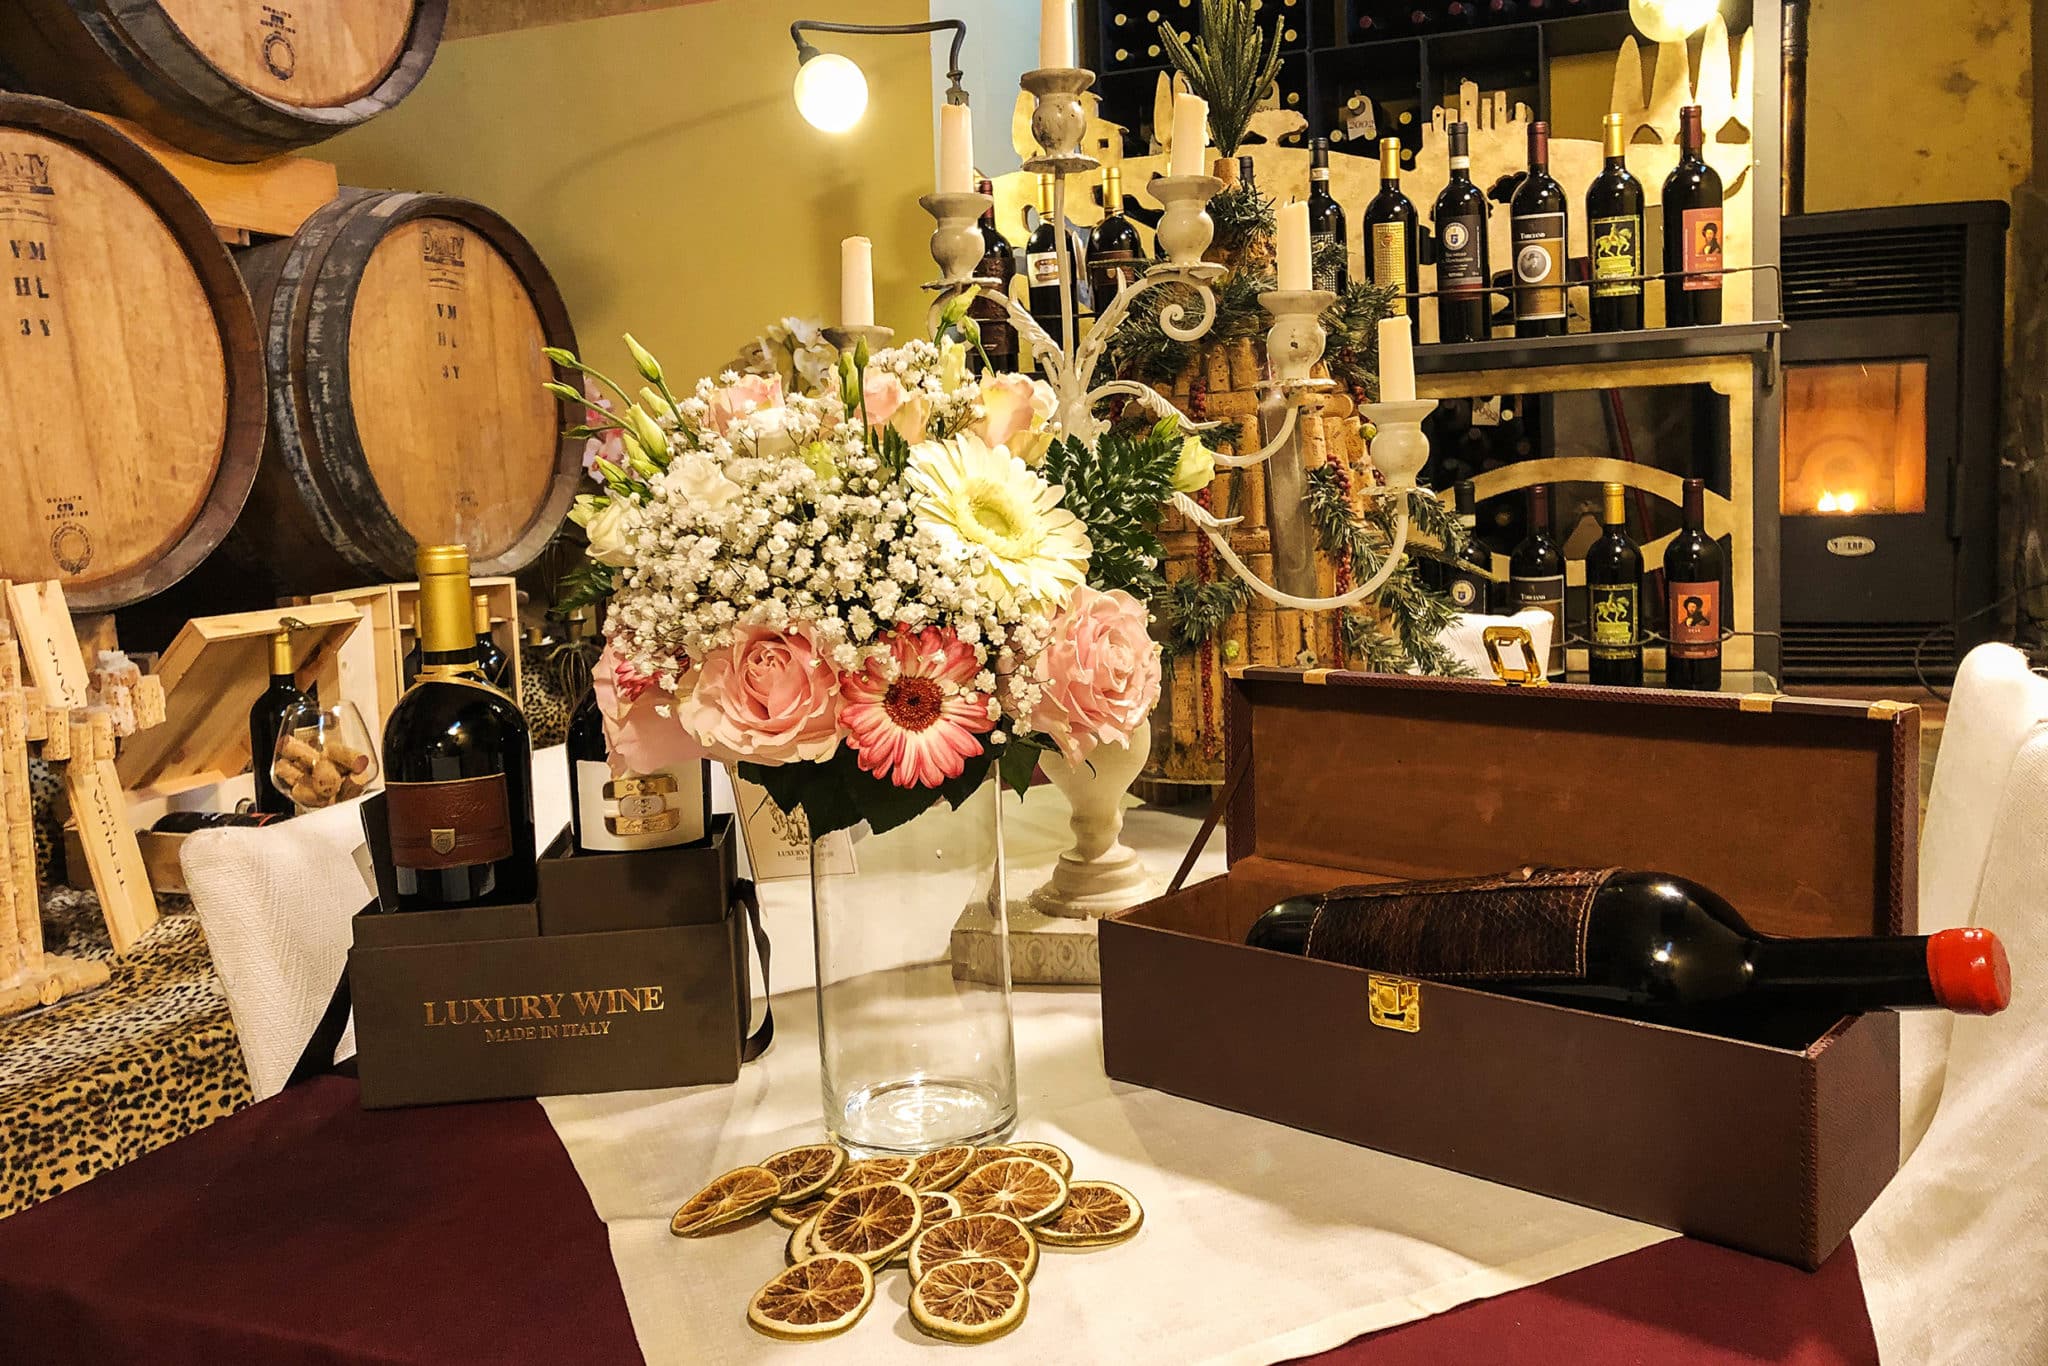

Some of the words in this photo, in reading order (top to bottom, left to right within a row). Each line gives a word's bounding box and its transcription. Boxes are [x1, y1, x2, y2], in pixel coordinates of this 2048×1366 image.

[423, 993, 564, 1027] LUXURY
[570, 985, 665, 1016] WINE
[484, 1025, 537, 1043] MADE
[539, 1024, 558, 1039] IN
[561, 1020, 611, 1038] ITALY
